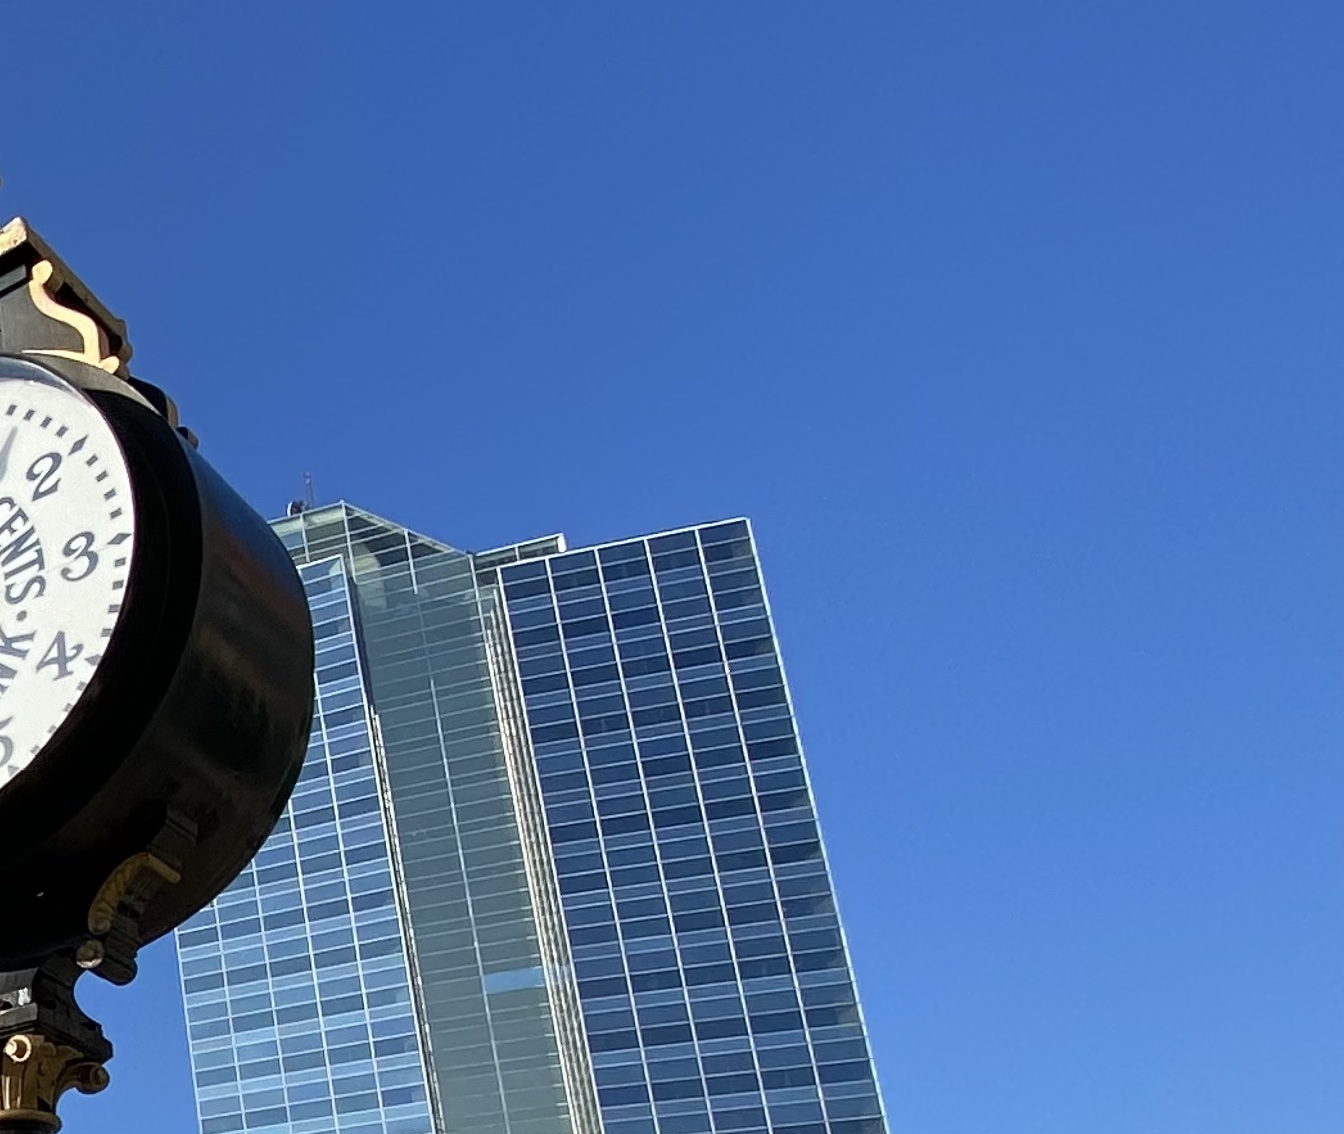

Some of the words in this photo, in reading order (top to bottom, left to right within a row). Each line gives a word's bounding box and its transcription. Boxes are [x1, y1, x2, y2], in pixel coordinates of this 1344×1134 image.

[25, 452, 61, 502] 2
[60, 531, 100, 581] 3
[35, 630, 84, 682] 4
